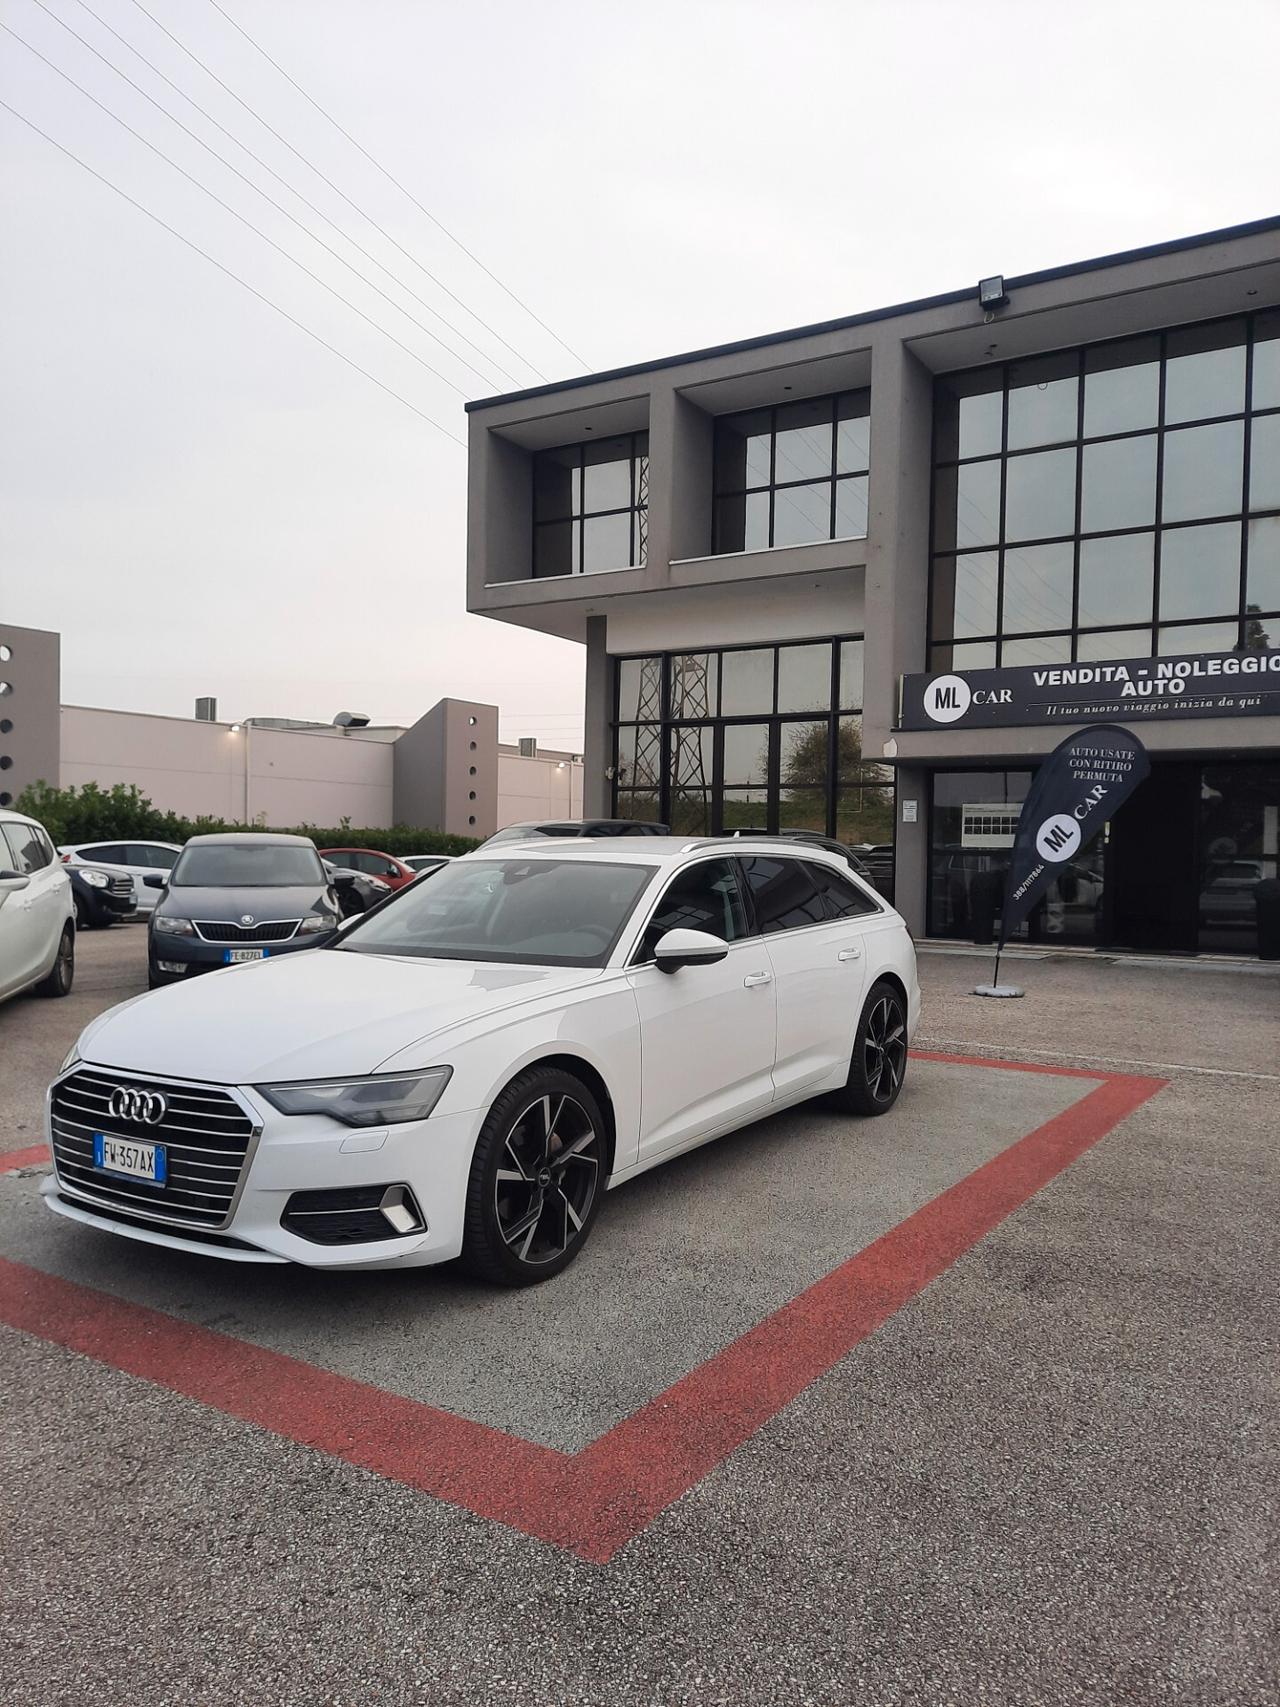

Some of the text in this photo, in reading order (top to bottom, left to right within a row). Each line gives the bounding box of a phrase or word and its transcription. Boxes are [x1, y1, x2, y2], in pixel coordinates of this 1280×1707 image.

[1033, 665, 1130, 687] VENDITA
[1157, 655, 1280, 679] NOLEGGIO
[1120, 678, 1186, 697] AUTO
[935, 686, 1013, 710] ML CAR
[1046, 695, 1262, 715] Il tuo nuovo viaggio inizia da qui
[1069, 747, 1135, 761] AUTO USATE
[1069, 758, 1132, 772] CON RITIRO
[1073, 770, 1123, 783] PERMUTA
[1043, 784, 1109, 853] ML CAR
